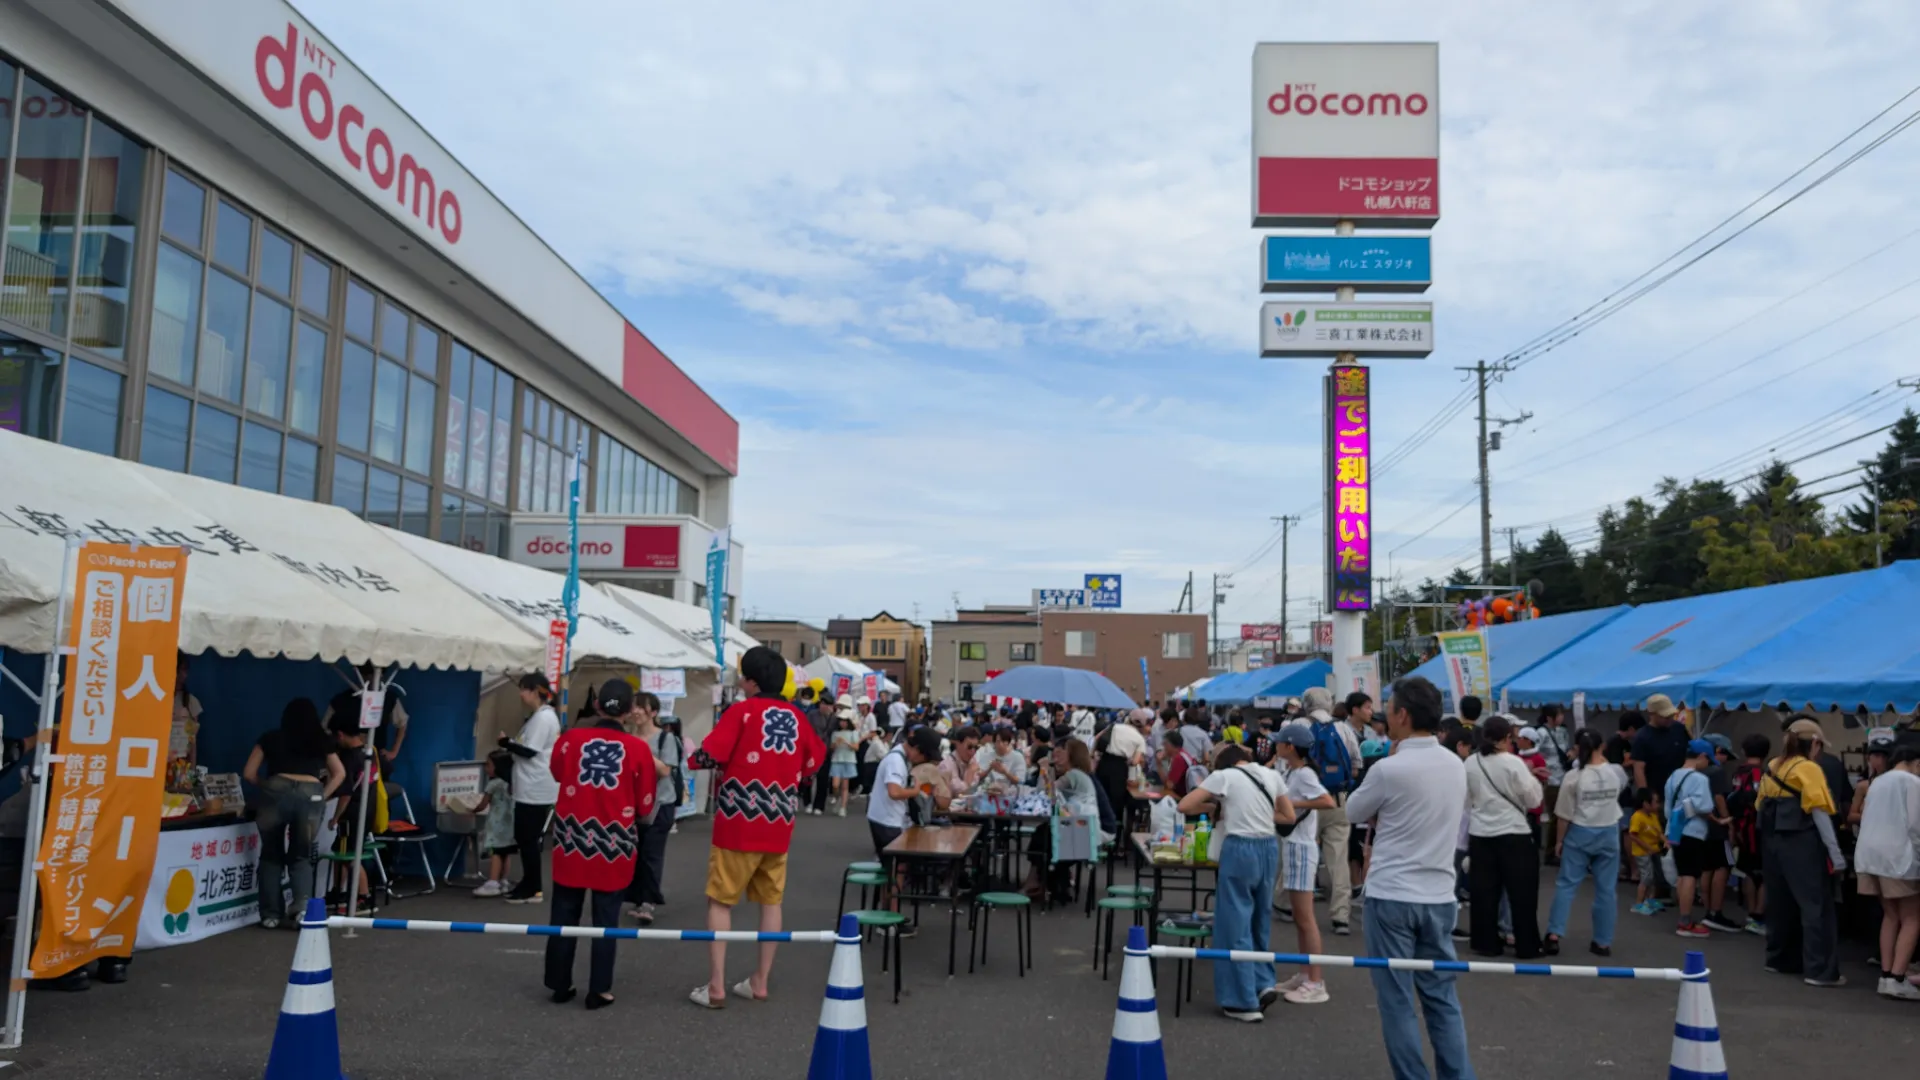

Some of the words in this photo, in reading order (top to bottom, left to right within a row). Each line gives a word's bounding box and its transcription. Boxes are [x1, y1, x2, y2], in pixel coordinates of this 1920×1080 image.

[304, 37, 336, 78] NTT
[1267, 84, 1428, 116] docomo
[255, 21, 462, 244] docomo
[1339, 177, 1431, 191] ドコモショップ
[1364, 195, 1431, 210] 札幌八軒店
[108, 556, 136, 567] Face
[137, 559, 147, 569] to
[149, 557, 176, 569] Face
[526, 536, 613, 555] docmo
[762, 706, 799, 755] 祭
[90, 575, 174, 948] 個人ローン
[578, 737, 626, 790] 祭
[199, 864, 260, 901] 北海道
